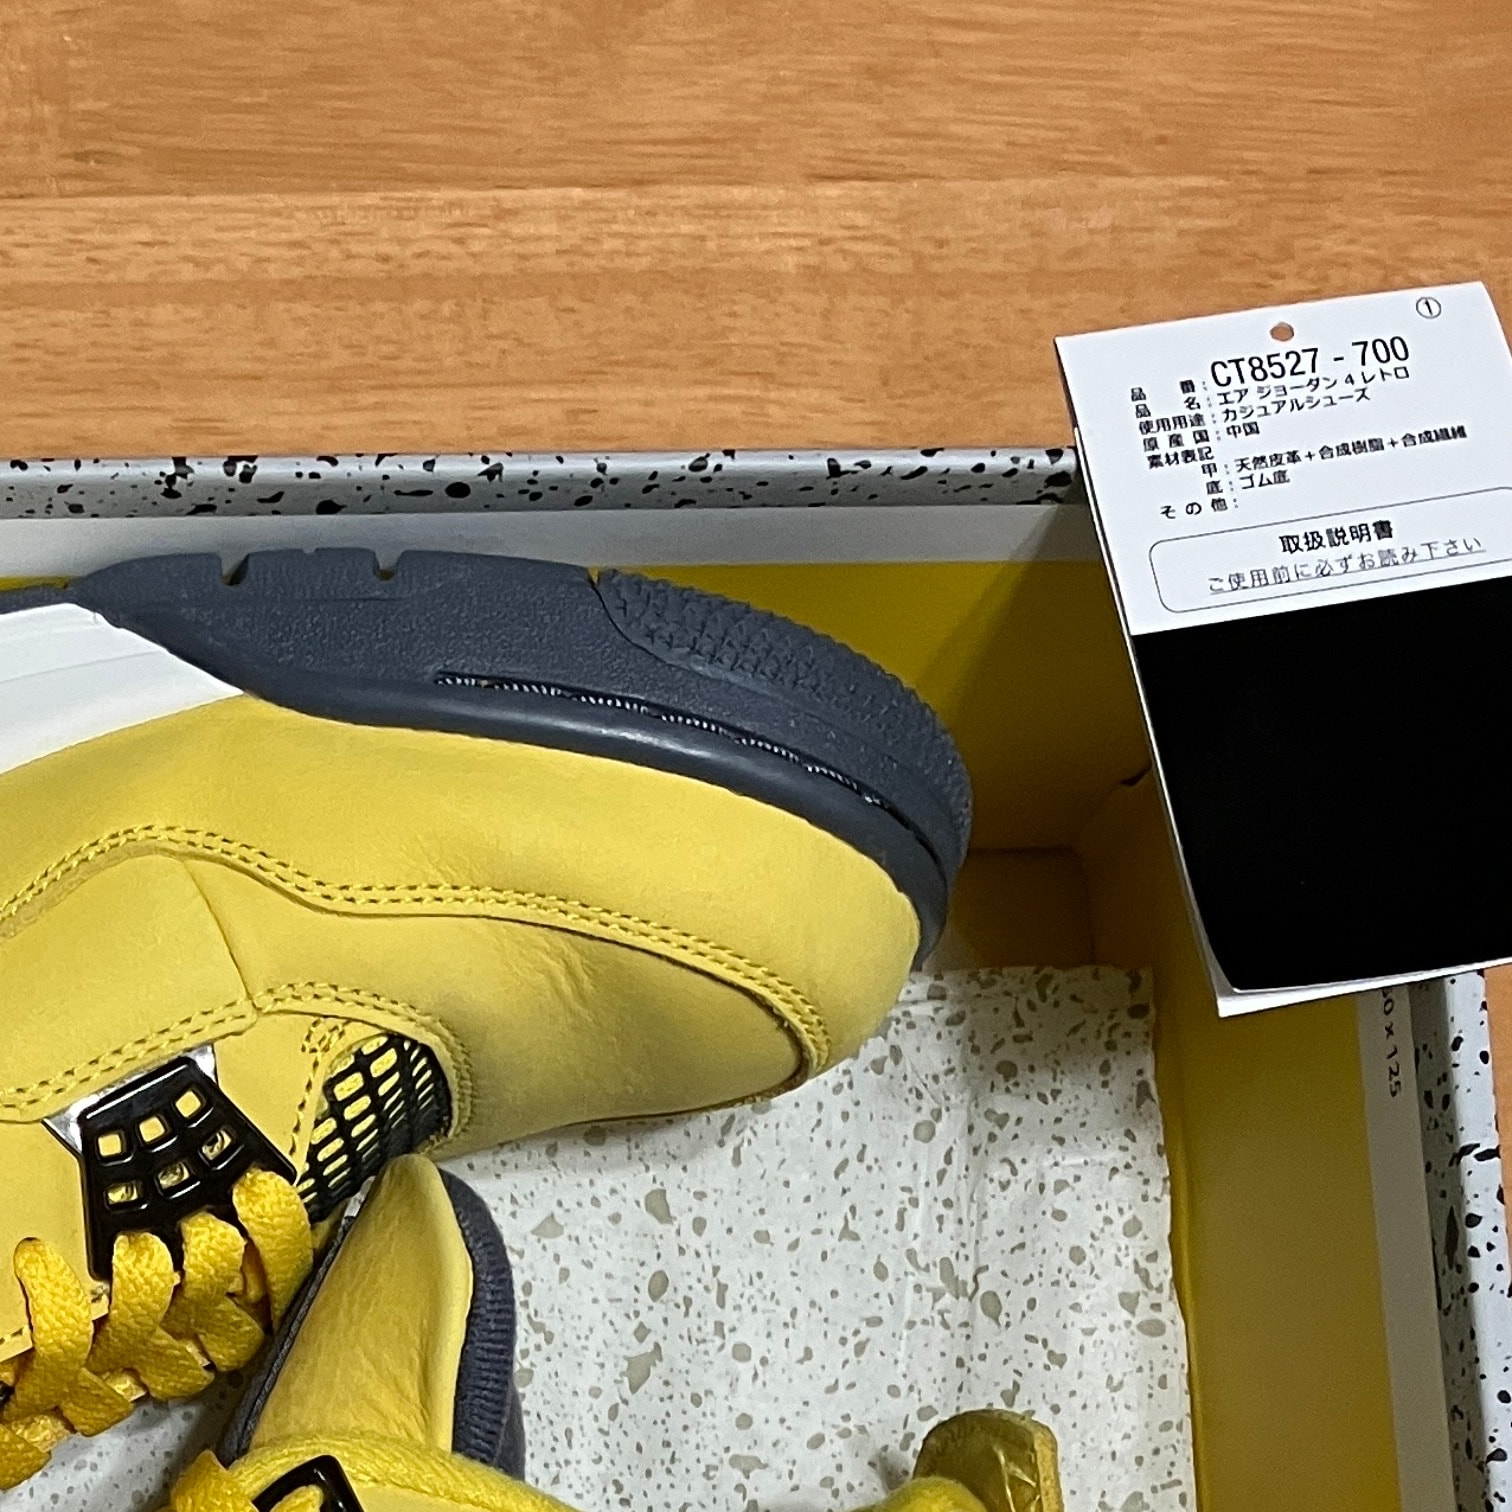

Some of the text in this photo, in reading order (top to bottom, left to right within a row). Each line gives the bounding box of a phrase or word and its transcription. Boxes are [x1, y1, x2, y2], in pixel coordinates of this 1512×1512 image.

[1278, 519, 1395, 555] 取扱説明書
[1207, 536, 1483, 593] ご使用前に必ずお読み下さい
